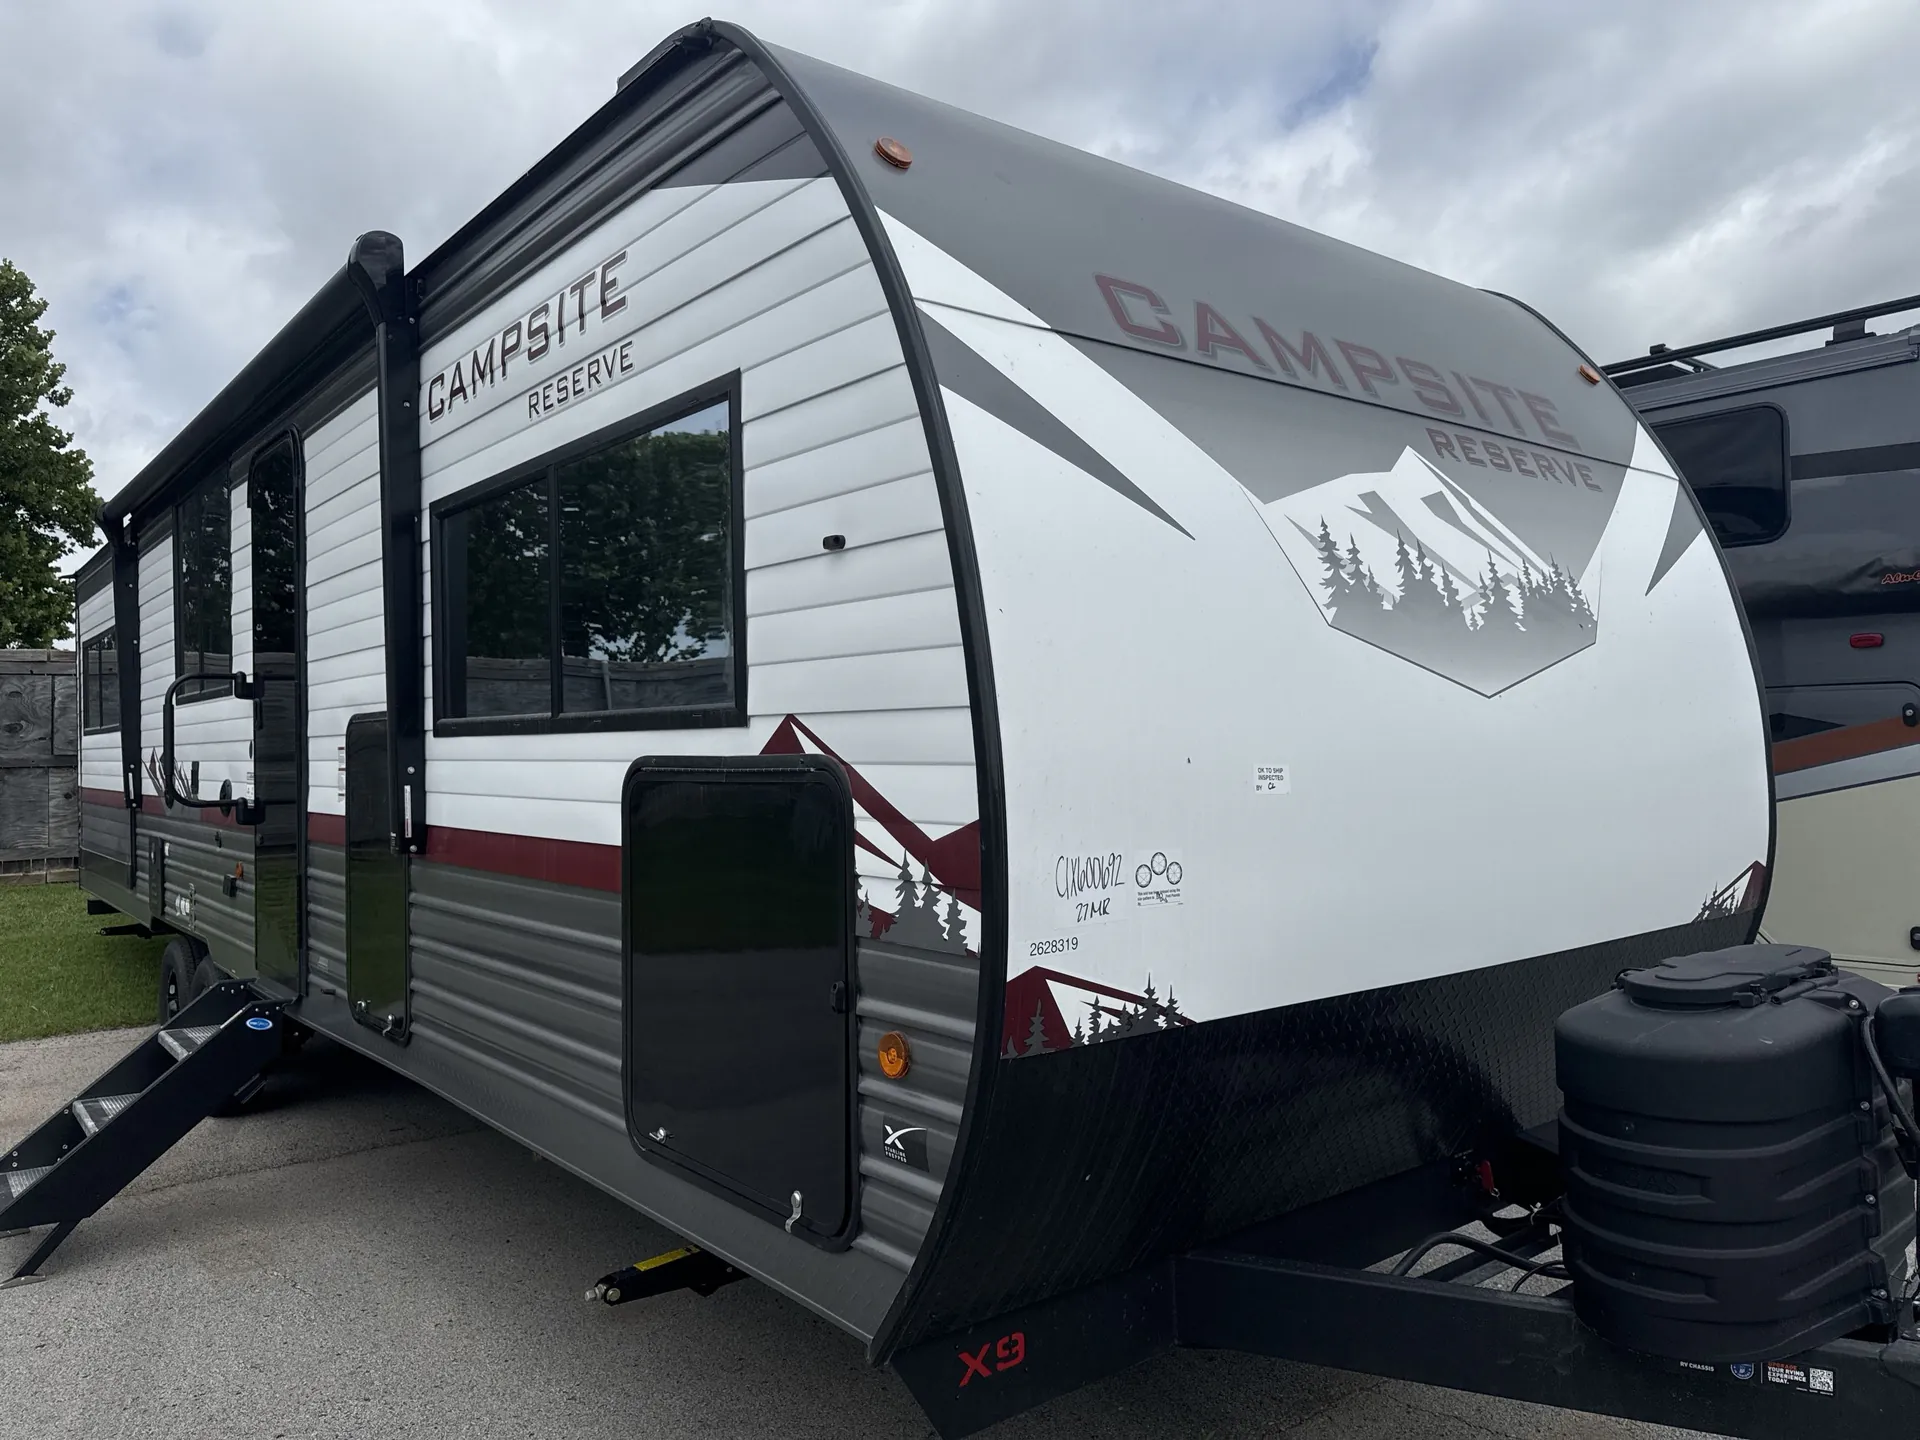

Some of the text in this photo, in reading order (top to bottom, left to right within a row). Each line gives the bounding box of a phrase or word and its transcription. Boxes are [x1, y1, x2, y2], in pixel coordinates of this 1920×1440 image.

[428, 250, 627, 421] CAMPSITE
[1093, 272, 1582, 450] CAMPSITE
[528, 340, 634, 421] RESERVE
[1425, 427, 1604, 493] RESERVE
[1029, 936, 1079, 956] 2628319
[958, 1331, 1025, 1388] X9
[1688, 1362, 1715, 1372] CHASSIS
[1768, 1366, 1785, 1374] YOUR
[1768, 1371, 1807, 1383] EXPERIENCE
[1768, 1376, 1790, 1385] TODAY.
